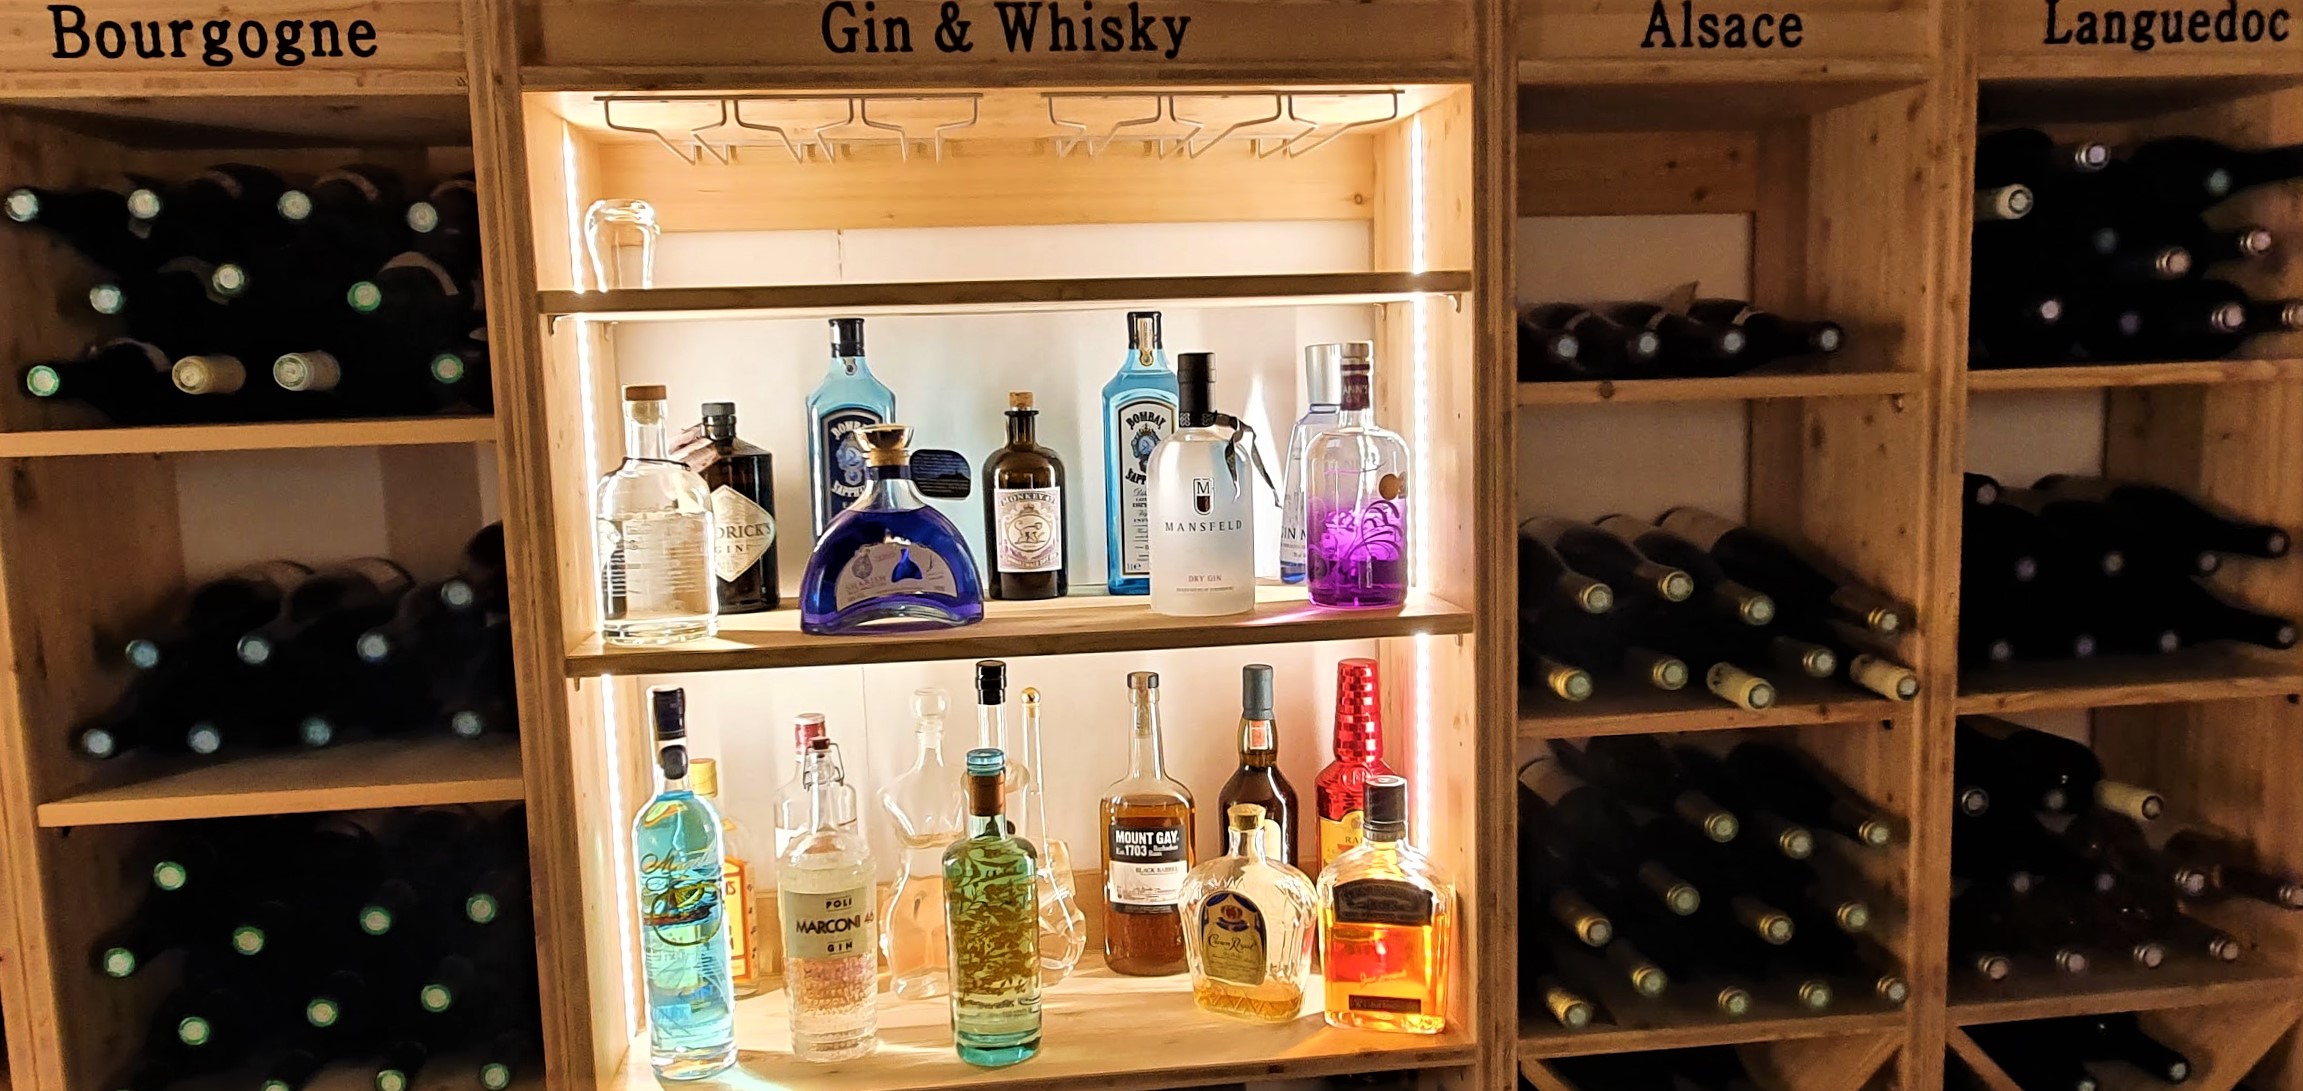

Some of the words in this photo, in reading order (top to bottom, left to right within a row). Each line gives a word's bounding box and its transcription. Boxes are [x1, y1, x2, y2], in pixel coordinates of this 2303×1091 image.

[821, 1, 914, 54] Gin
[934, 1, 974, 53] &
[994, 1, 1192, 60] Whisky
[1640, 0, 1804, 49] Alsace
[2043, 0, 2290, 53] Languedoc
[47, 4, 379, 67] Bourgogne
[1126, 411, 1166, 430] BOMBAY
[830, 420, 867, 441] BOMB
[1125, 468, 1147, 485] SAPP
[1197, 482, 1210, 494] M
[717, 523, 771, 538] DRICK'S
[1165, 520, 1242, 532] MANSFELD
[1188, 575, 1204, 583] DRY
[1207, 575, 1222, 583] GIN
[1115, 830, 1154, 845] MOUNT
[1156, 830, 1179, 845] GAY
[1125, 845, 1147, 857] 1703
[826, 897, 852, 909] POLI
[796, 915, 861, 934] MARCONI
[827, 941, 853, 953] GIN
